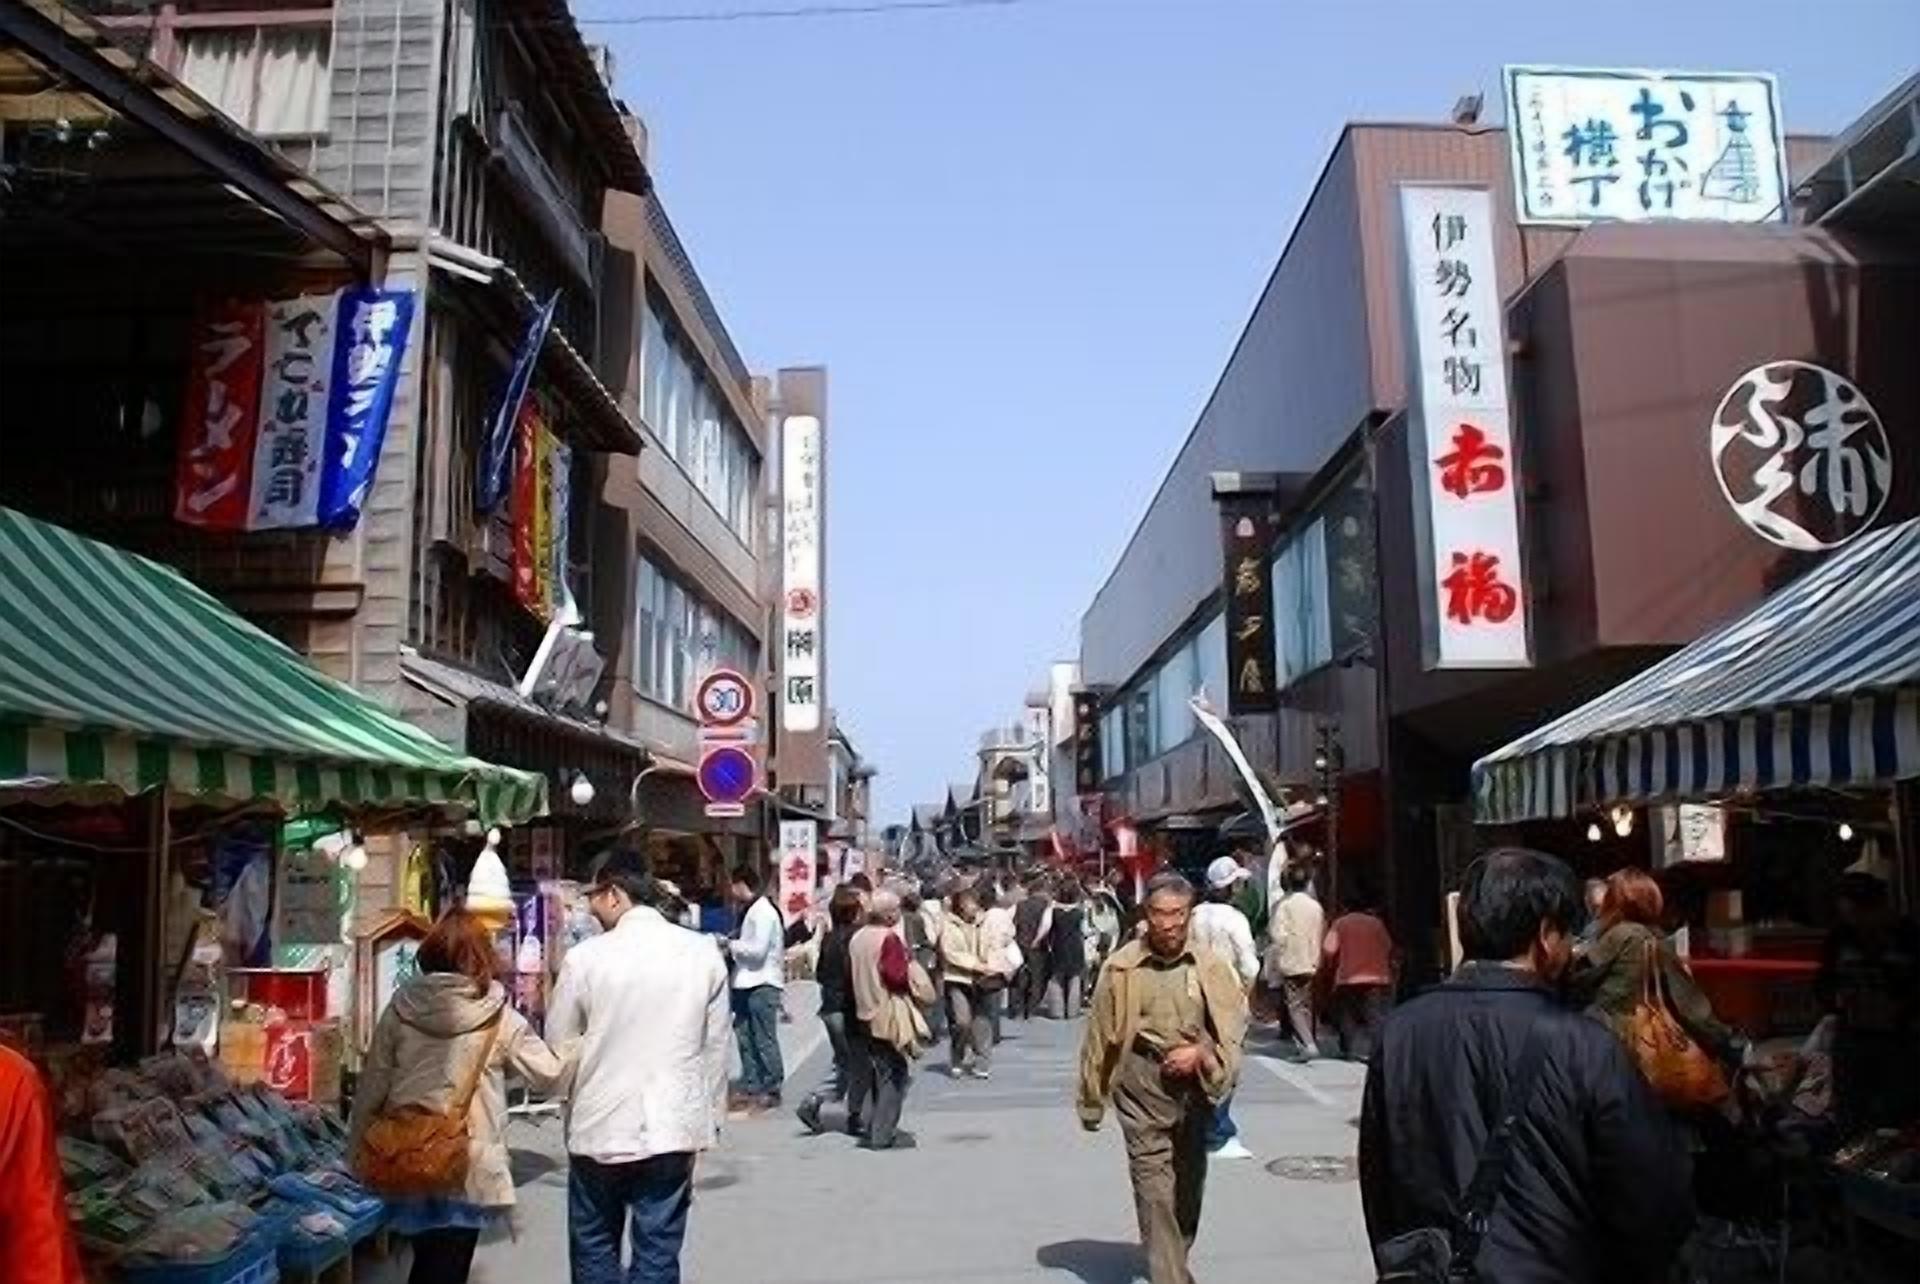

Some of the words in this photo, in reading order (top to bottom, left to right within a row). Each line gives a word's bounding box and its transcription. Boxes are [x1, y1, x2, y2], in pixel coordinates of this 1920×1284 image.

[1561, 115, 1621, 208] 横丁
[1629, 88, 1695, 210] おかげ
[1431, 212, 1481, 397] 伊勢名物
[187, 321, 252, 512] ラーメン
[1434, 424, 1516, 625] 赤福
[711, 687, 740, 712] 30
